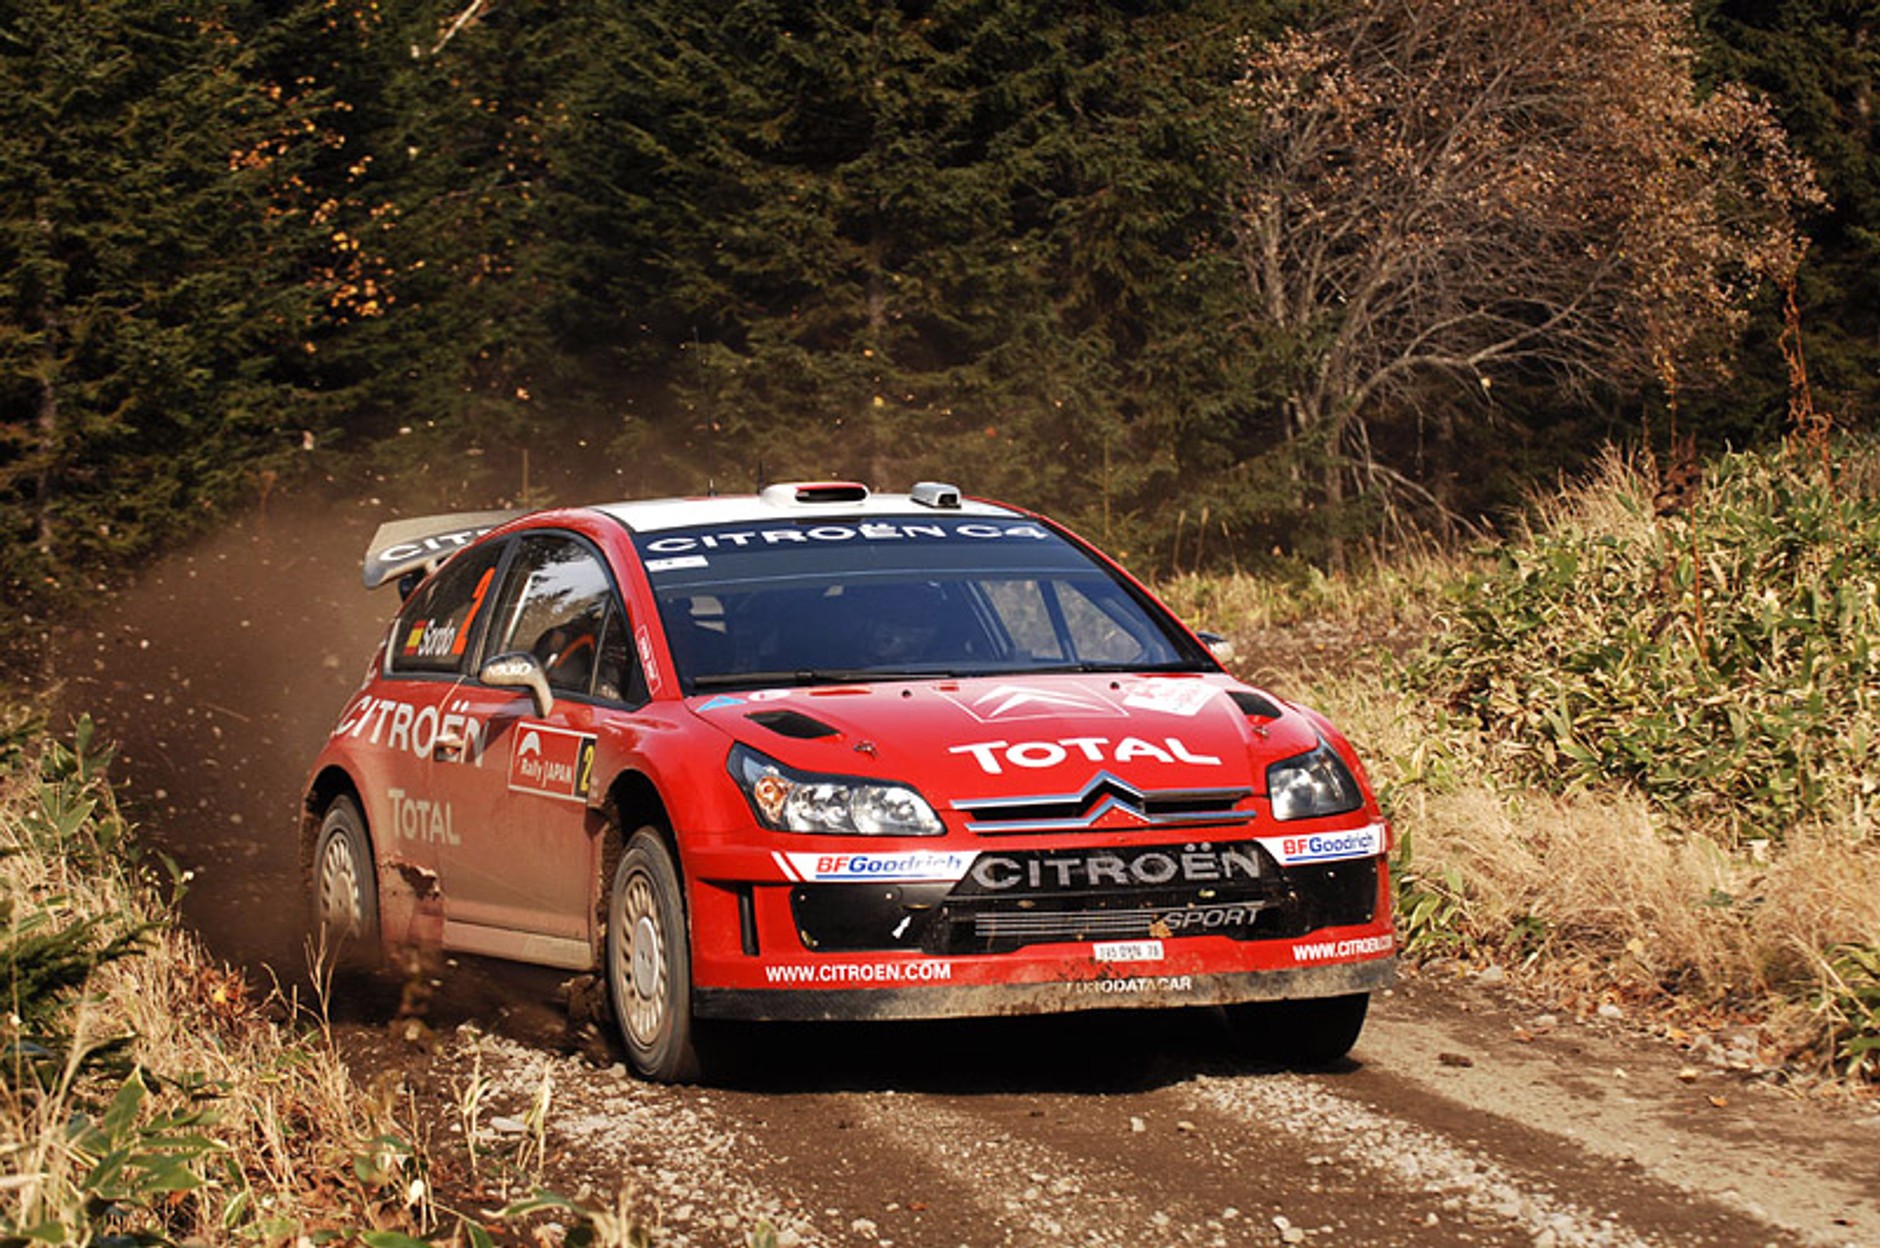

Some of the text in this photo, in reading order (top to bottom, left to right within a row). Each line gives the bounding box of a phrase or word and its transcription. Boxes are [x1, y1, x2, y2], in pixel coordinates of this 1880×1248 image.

[955, 523, 1049, 540] C4
[417, 617, 456, 657] Sordo
[580, 745, 595, 792] 2
[948, 736, 1222, 775] TOTAL
[521, 757, 572, 789] Rally JAPAN
[1282, 831, 1375, 855] BFGoodrich
[815, 855, 962, 874] BFGoodrich
[970, 841, 1262, 890] CITROËN
[1163, 906, 1264, 930] SPORT
[766, 961, 952, 983] WWW.CITROEN.COM
